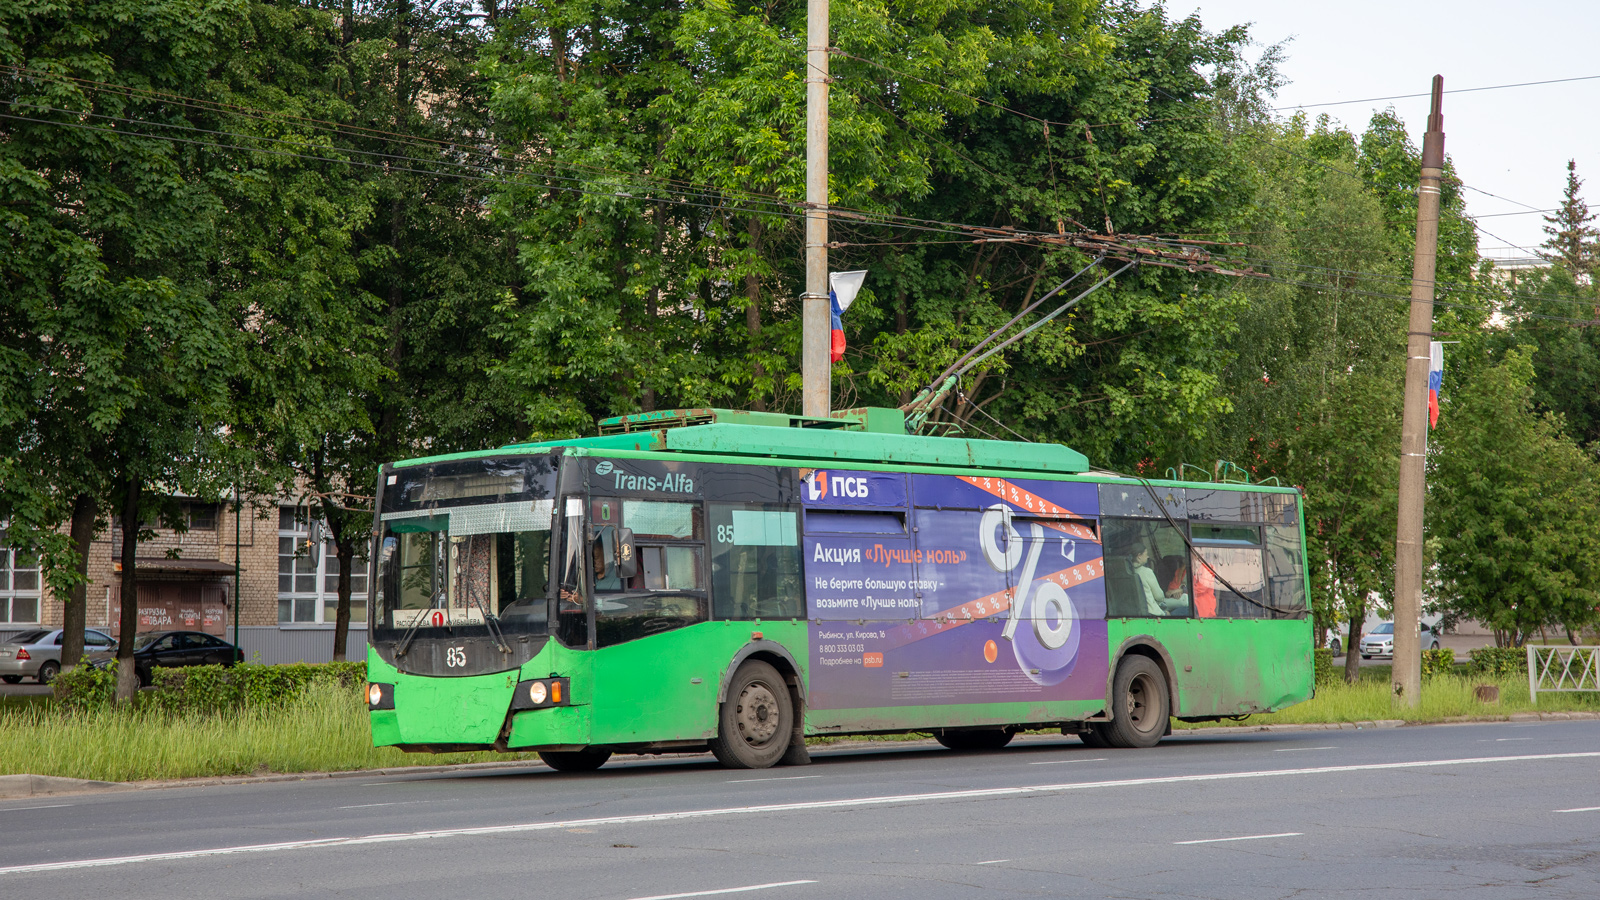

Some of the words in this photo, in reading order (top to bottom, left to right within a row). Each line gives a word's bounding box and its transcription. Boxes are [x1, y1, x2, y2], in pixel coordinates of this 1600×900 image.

[613, 469, 694, 493] Trans-Alfa
[831, 476, 869, 498] ПСБ
[717, 524, 734, 543] 85
[813, 542, 861, 566] Акция
[865, 543, 923, 568] «Лучше
[926, 549, 967, 565] ноль»
[815, 577, 828, 590] Не
[829, 577, 863, 592] берите
[864, 577, 906, 592] большую
[908, 580, 938, 592] ставку
[816, 598, 859, 609] возьмите
[860, 596, 896, 610] «Лучше
[148, 616, 172, 625] ОВАРА
[434, 612, 441, 627] 1
[818, 631, 846, 640] Рыбинск,
[855, 631, 879, 640] Кирова,
[879, 630, 886, 639] 16
[819, 645, 824, 653] 8
[837, 644, 847, 652] 333
[847, 644, 856, 652] 03
[856, 643, 865, 652] 03
[446, 646, 467, 668] 85
[819, 657, 853, 667] Подробнее
[864, 655, 882, 666] psb.ru
